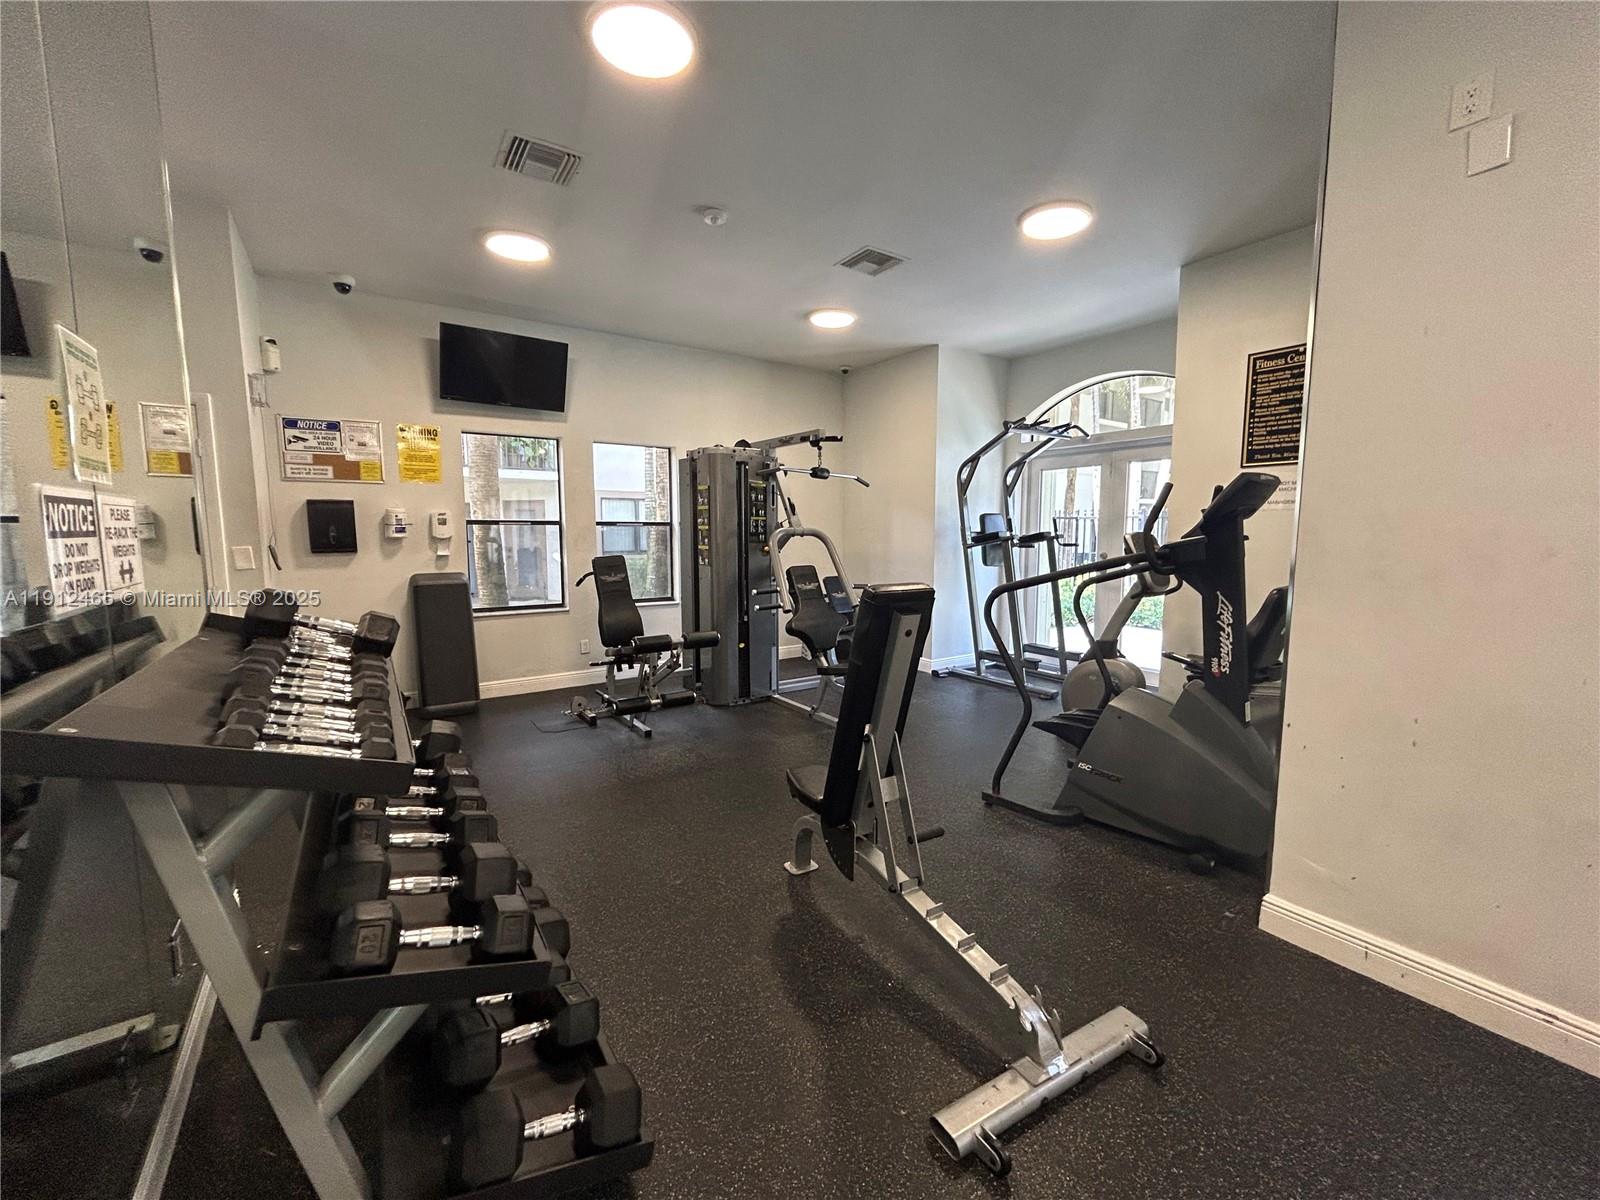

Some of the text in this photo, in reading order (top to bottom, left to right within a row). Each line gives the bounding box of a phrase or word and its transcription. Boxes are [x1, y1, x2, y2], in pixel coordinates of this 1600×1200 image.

[1255, 358, 1286, 369] Fitness
[297, 420, 328, 430] NOTICE
[47, 502, 95, 532] NOTICE
[109, 507, 131, 522] PLEASE
[64, 542, 89, 558] DO NOT
[112, 544, 136, 558] WEIGHTS
[53, 558, 100, 579] DROP WEIGHTS
[75, 576, 96, 593] FLOOR
